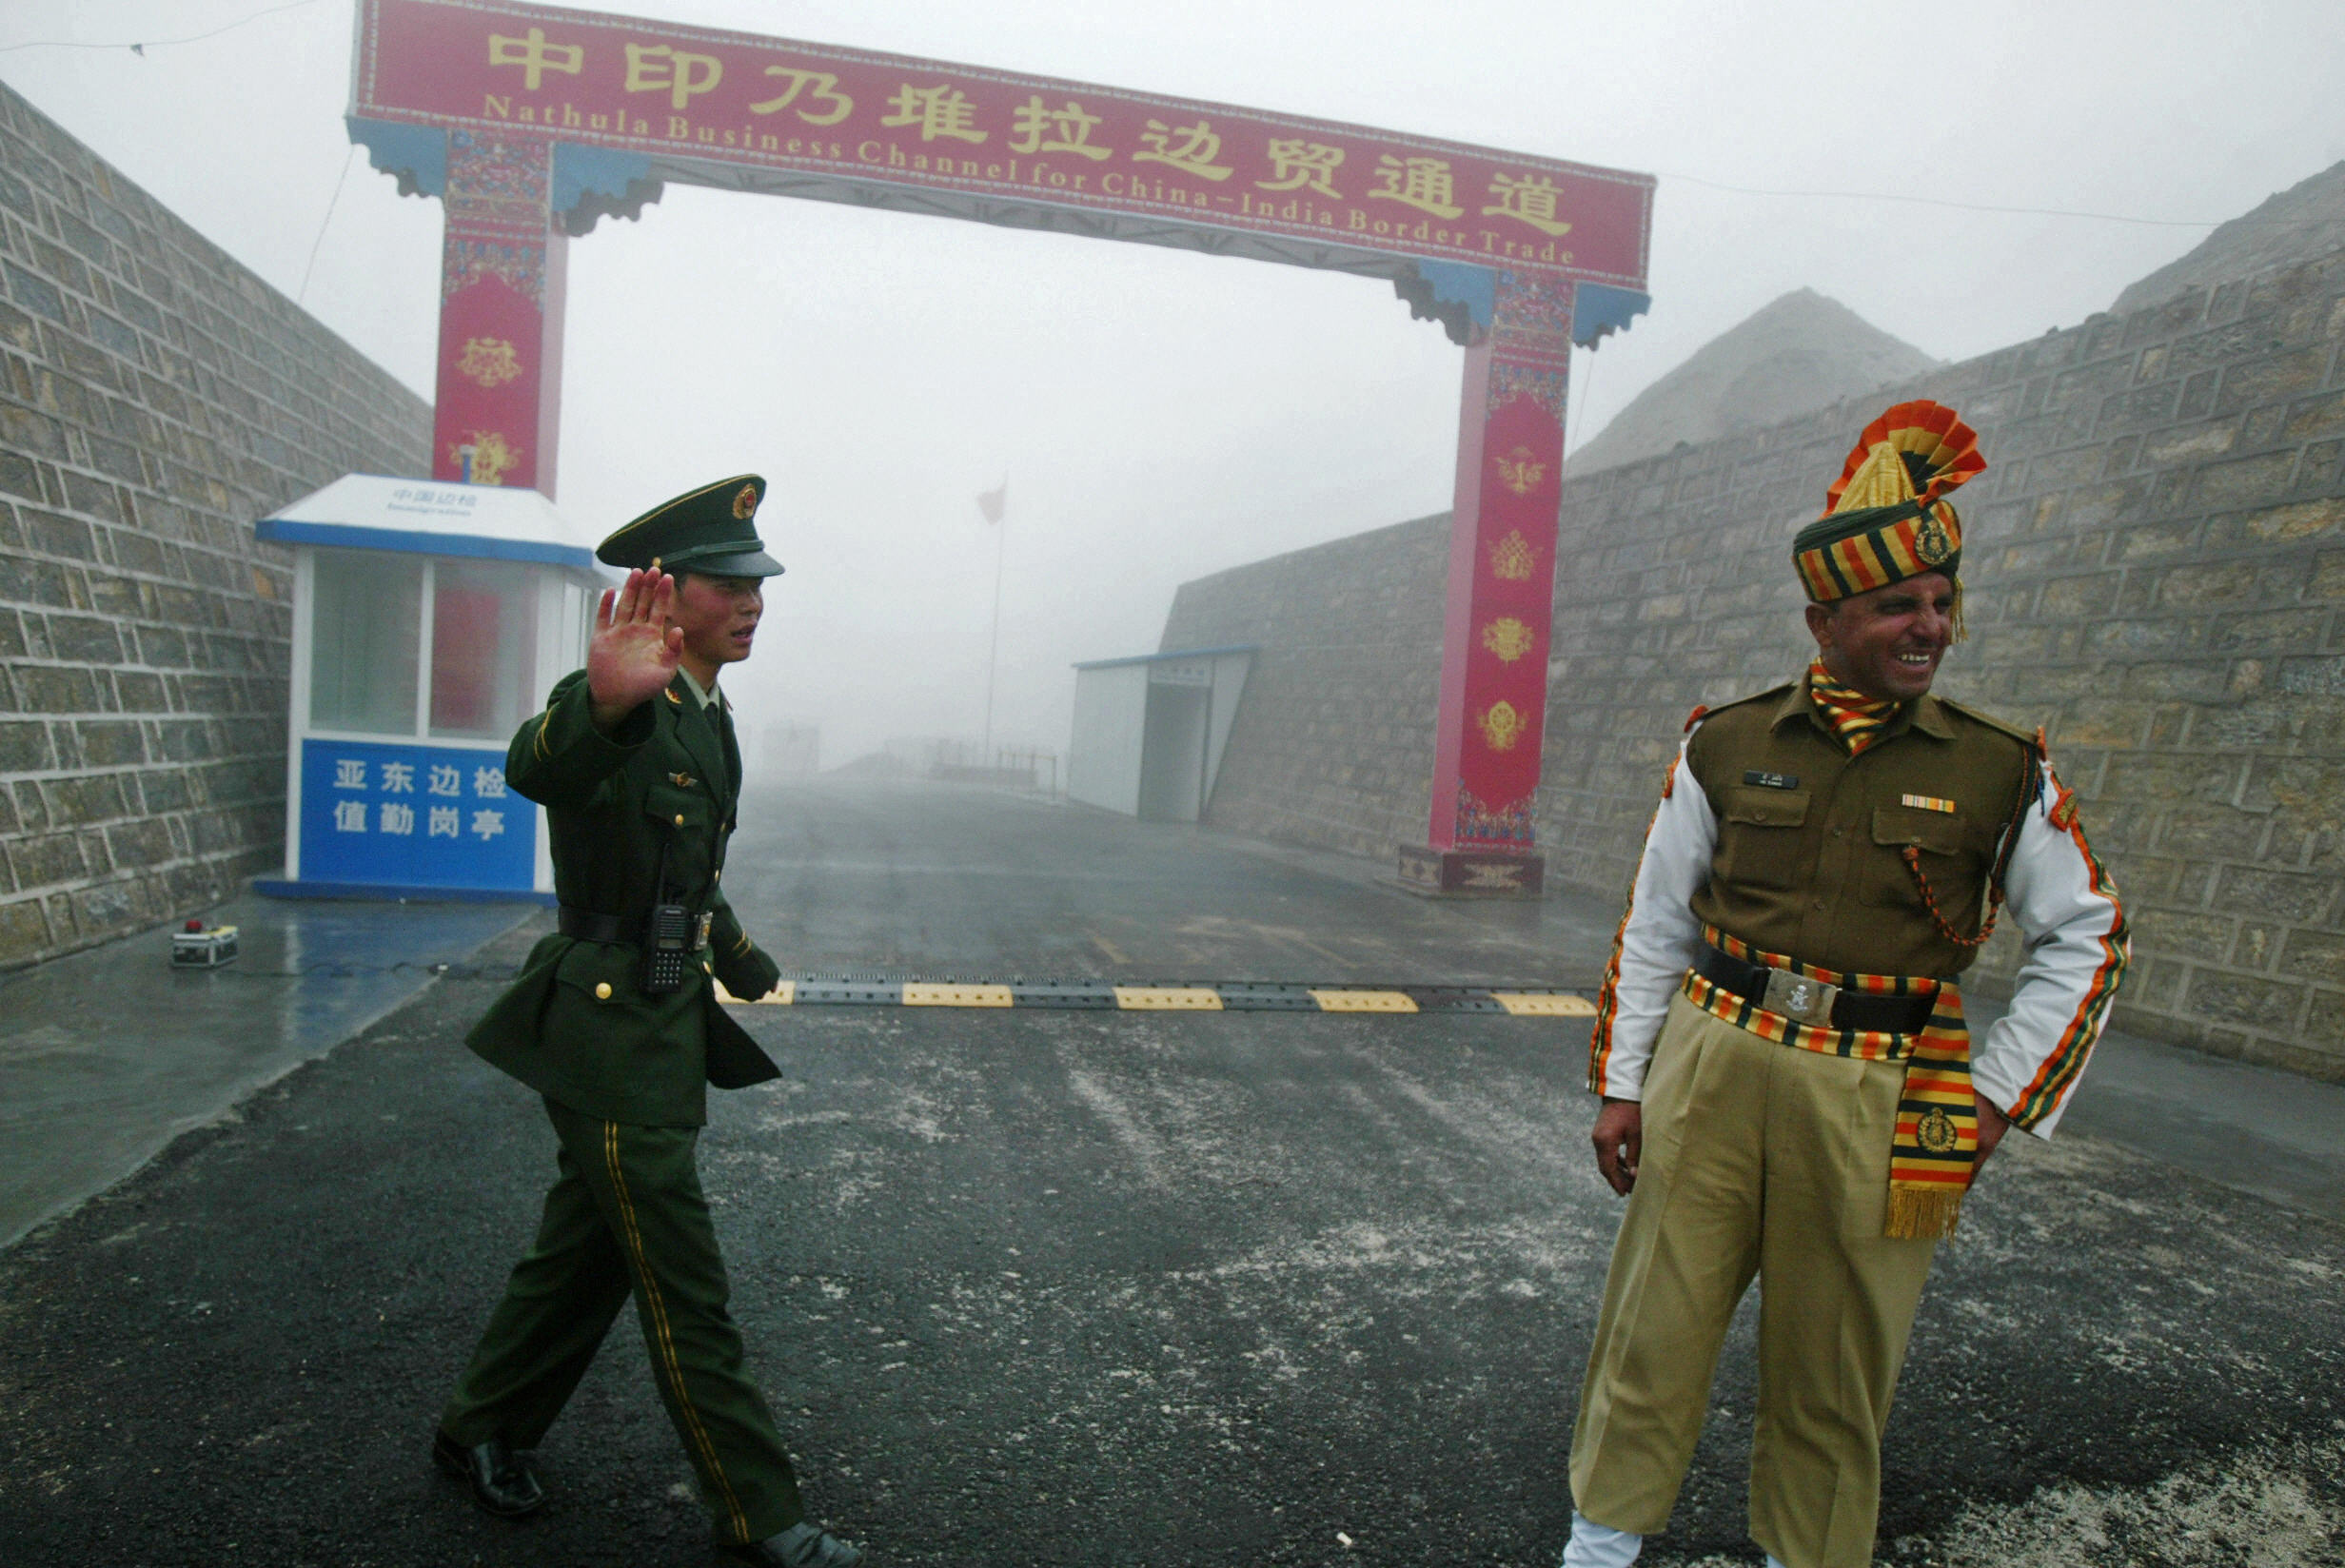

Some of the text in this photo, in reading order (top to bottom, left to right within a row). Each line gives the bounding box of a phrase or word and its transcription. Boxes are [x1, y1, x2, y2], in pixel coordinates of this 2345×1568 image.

[483, 93, 651, 135] Nathula
[668, 116, 842, 159] Business
[857, 141, 1016, 181] Channel
[1033, 162, 1087, 189] for
[1348, 208, 1467, 246] Border
[1479, 230, 1574, 265] Trade
[487, 27, 1573, 236] 中印乃堆拉边贸通道
[333, 759, 507, 799] 亚东边检
[333, 800, 505, 841] 值勤岗亭
